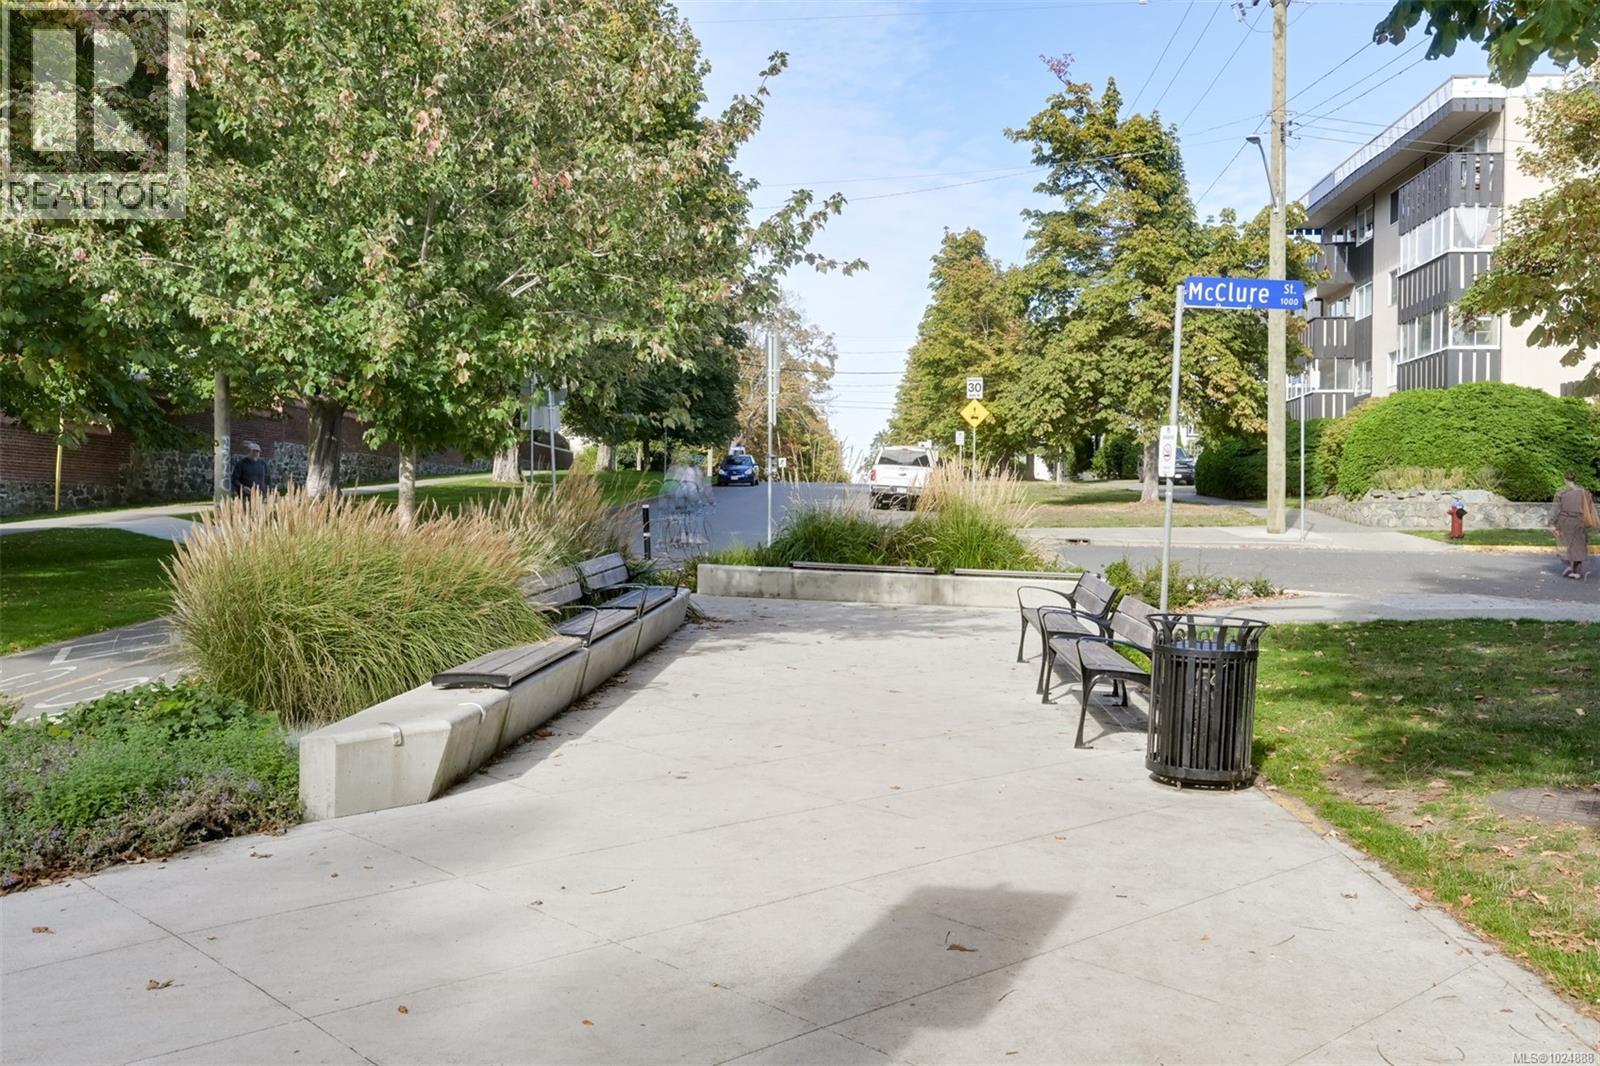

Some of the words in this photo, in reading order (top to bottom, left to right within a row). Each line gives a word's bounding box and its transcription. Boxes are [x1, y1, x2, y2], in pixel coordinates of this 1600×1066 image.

[1188, 282, 1270, 304] McClure
[1283, 283, 1297, 295] St.
[1280, 298, 1299, 306] 1000
[968, 382, 982, 393] 30
